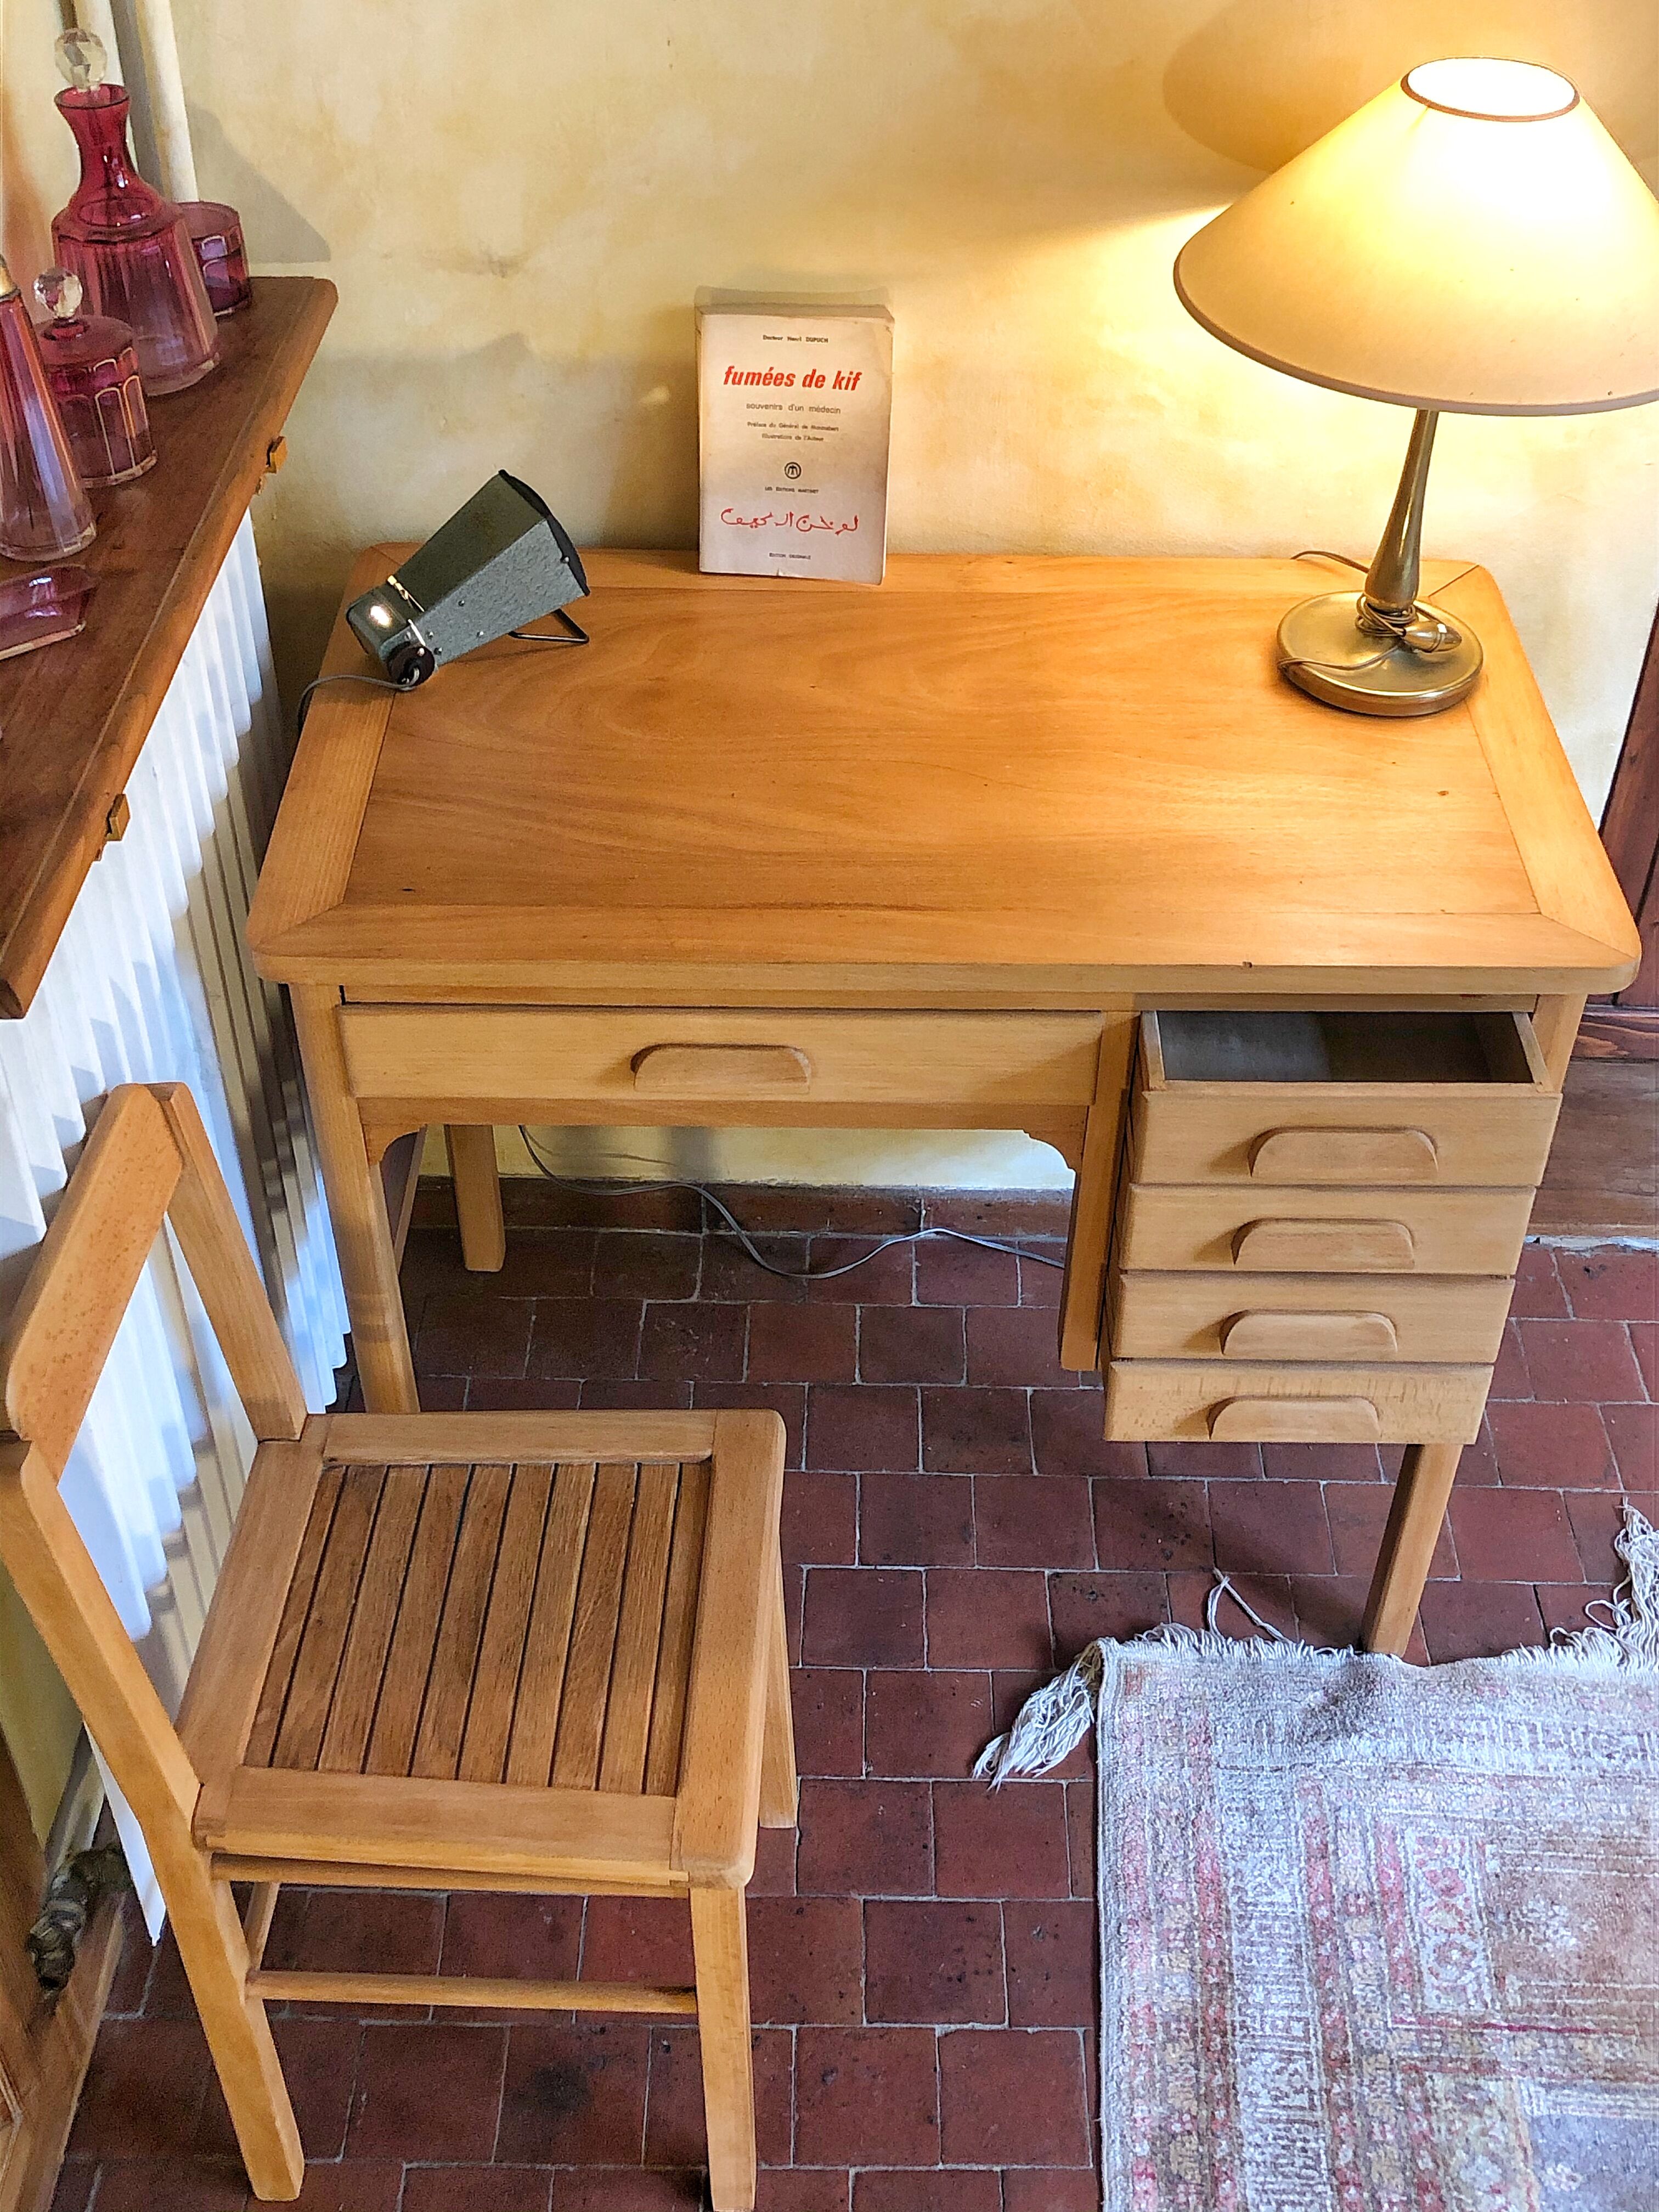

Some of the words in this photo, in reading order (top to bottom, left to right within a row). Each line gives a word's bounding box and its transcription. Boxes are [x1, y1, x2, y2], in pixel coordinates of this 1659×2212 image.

[723, 365, 796, 387] fumées
[802, 368, 826, 389] de
[832, 370, 862, 391] kif
[746, 403, 783, 411] souvenirs
